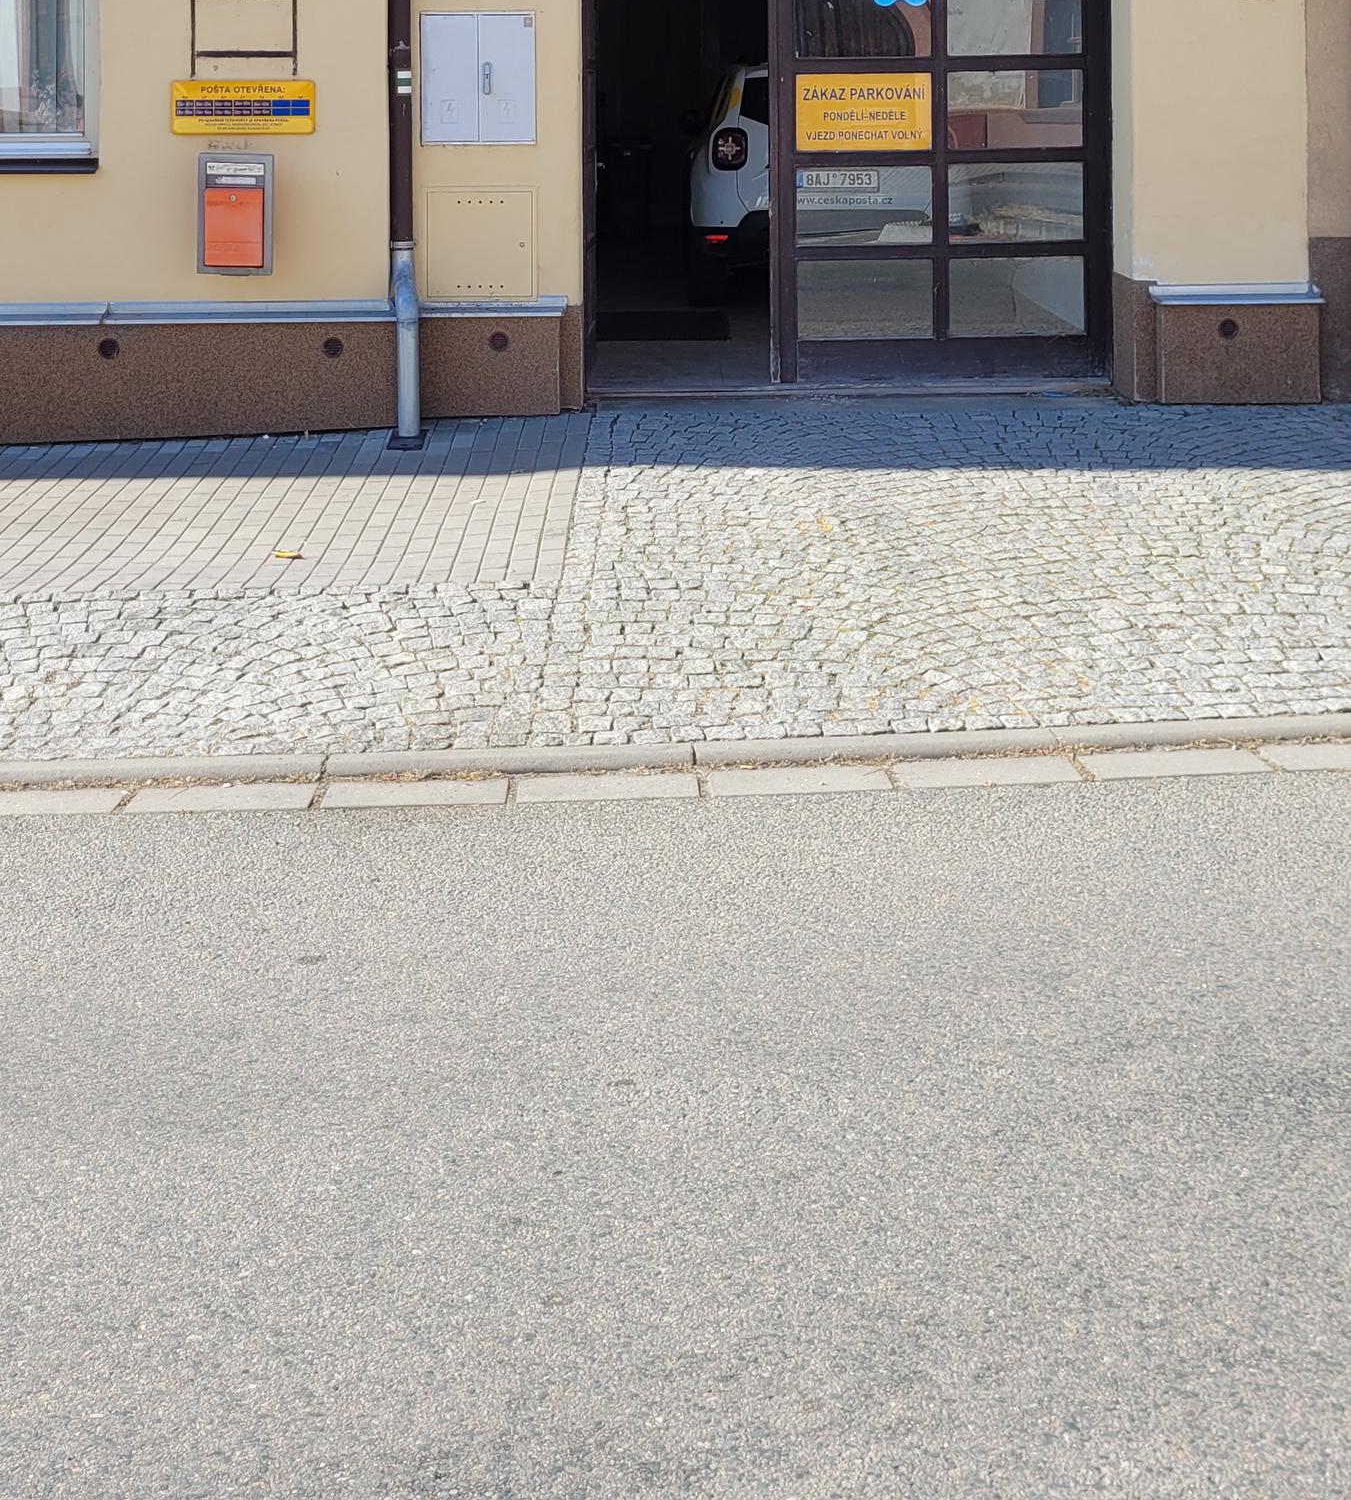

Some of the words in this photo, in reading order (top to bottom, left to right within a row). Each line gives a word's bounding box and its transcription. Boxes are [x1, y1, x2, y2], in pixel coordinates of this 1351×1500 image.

[200, 84, 231, 94] POŠTA
[233, 84, 286, 94] OTEVŘENA:
[802, 84, 846, 101] ZÁKAZ
[850, 84, 926, 101] PARKOVÁNÍ
[806, 131, 836, 141] VJEZD
[838, 130, 889, 141] PONECHAT
[892, 128, 924, 140] VOLNÝ
[806, 173, 830, 186] 8AJ
[840, 173, 872, 186] 7953
[798, 196, 893, 206] ww.ceskaposta.cz
